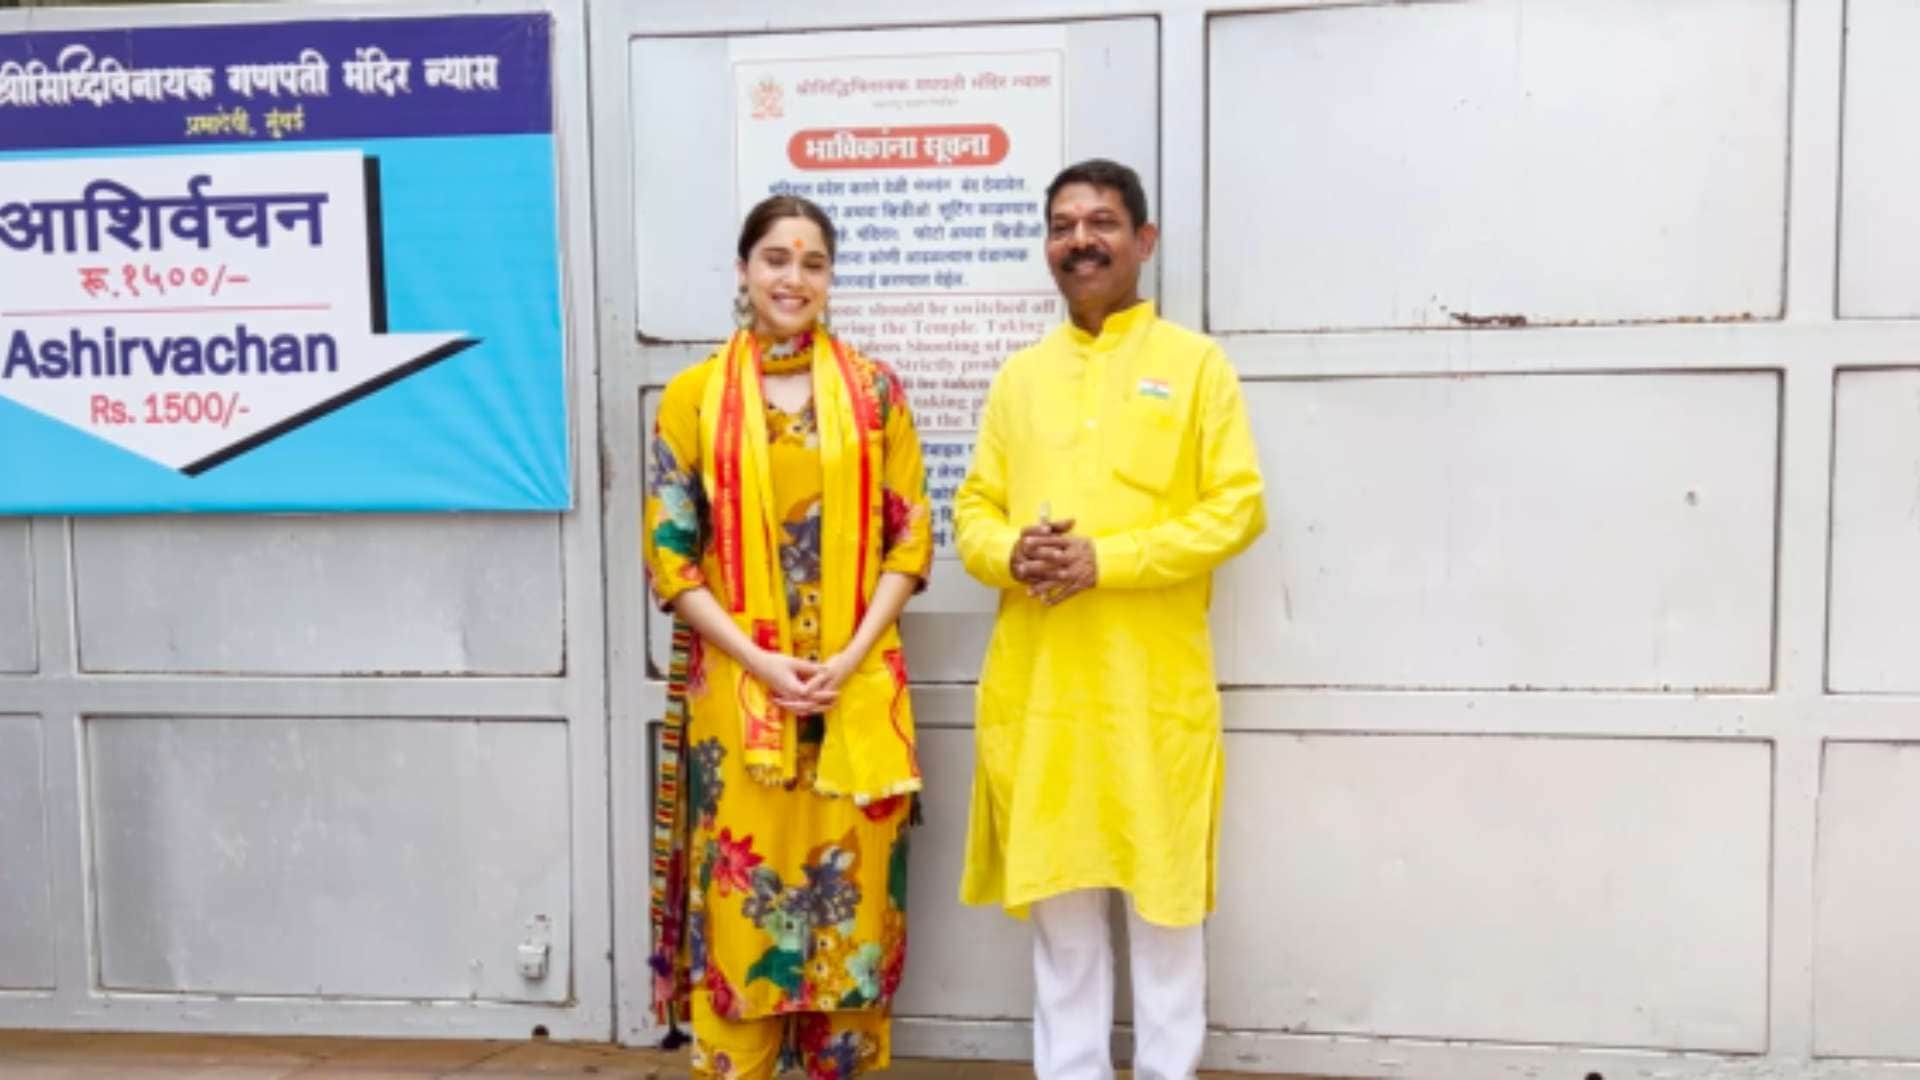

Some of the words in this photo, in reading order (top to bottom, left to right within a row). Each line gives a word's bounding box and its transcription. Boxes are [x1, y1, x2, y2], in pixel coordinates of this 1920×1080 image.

[226, 49, 329, 98] गणपती
[341, 46, 411, 96] मंदिर
[423, 54, 499, 90] न्यास
[805, 127, 917, 160] भाविकांना
[923, 133, 990, 165] सूचना
[0, 175, 328, 253] आशिर्वचन
[868, 301, 924, 316] should
[929, 301, 949, 315] be
[954, 300, 1028, 315] switched
[882, 321, 907, 335] the
[988, 317, 1044, 335] Taking
[2, 325, 338, 379] Ashirvachan
[91, 395, 135, 424] Rs.
[145, 393, 250, 427] 1500/-
[937, 412, 961, 427] the
